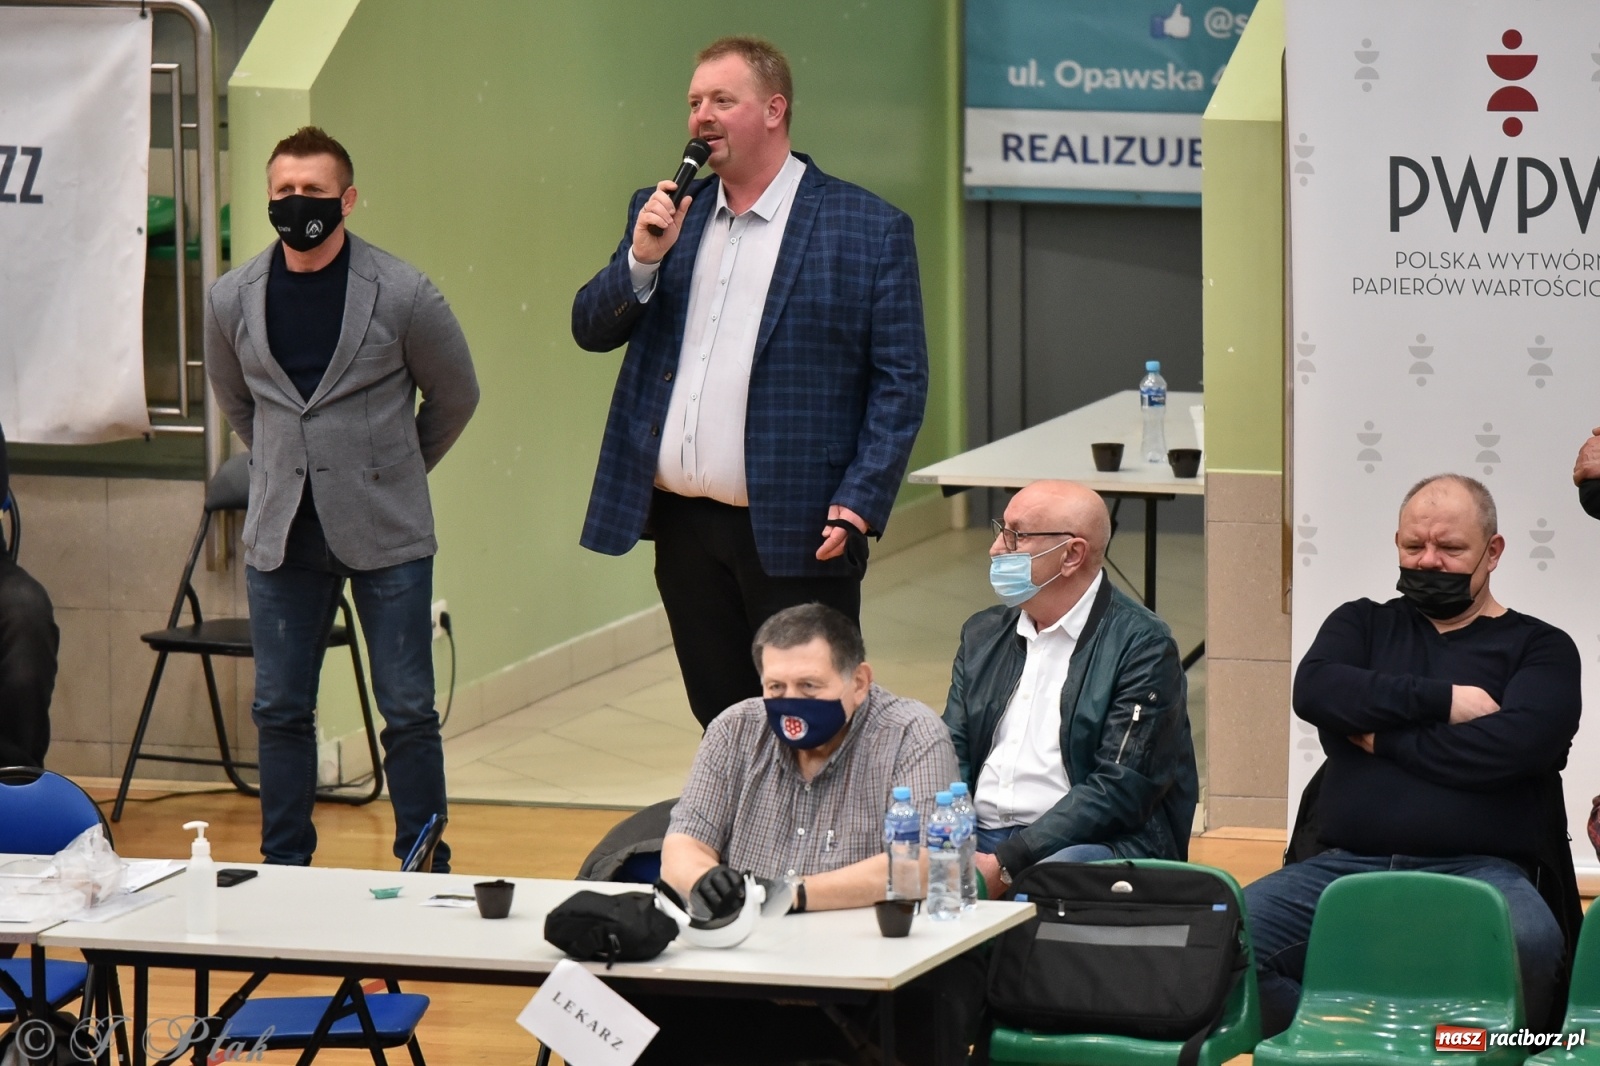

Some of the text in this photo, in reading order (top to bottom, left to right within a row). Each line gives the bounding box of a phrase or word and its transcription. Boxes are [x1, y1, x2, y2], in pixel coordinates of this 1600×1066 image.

[1008, 59, 1045, 88] ul.
[1055, 60, 1204, 93] Opawska
[1395, 248, 1600, 271] POLSKA WYTWÓR
[1352, 273, 1465, 296] PAPIERÓW
[552, 991, 624, 1051] LEKARZ
